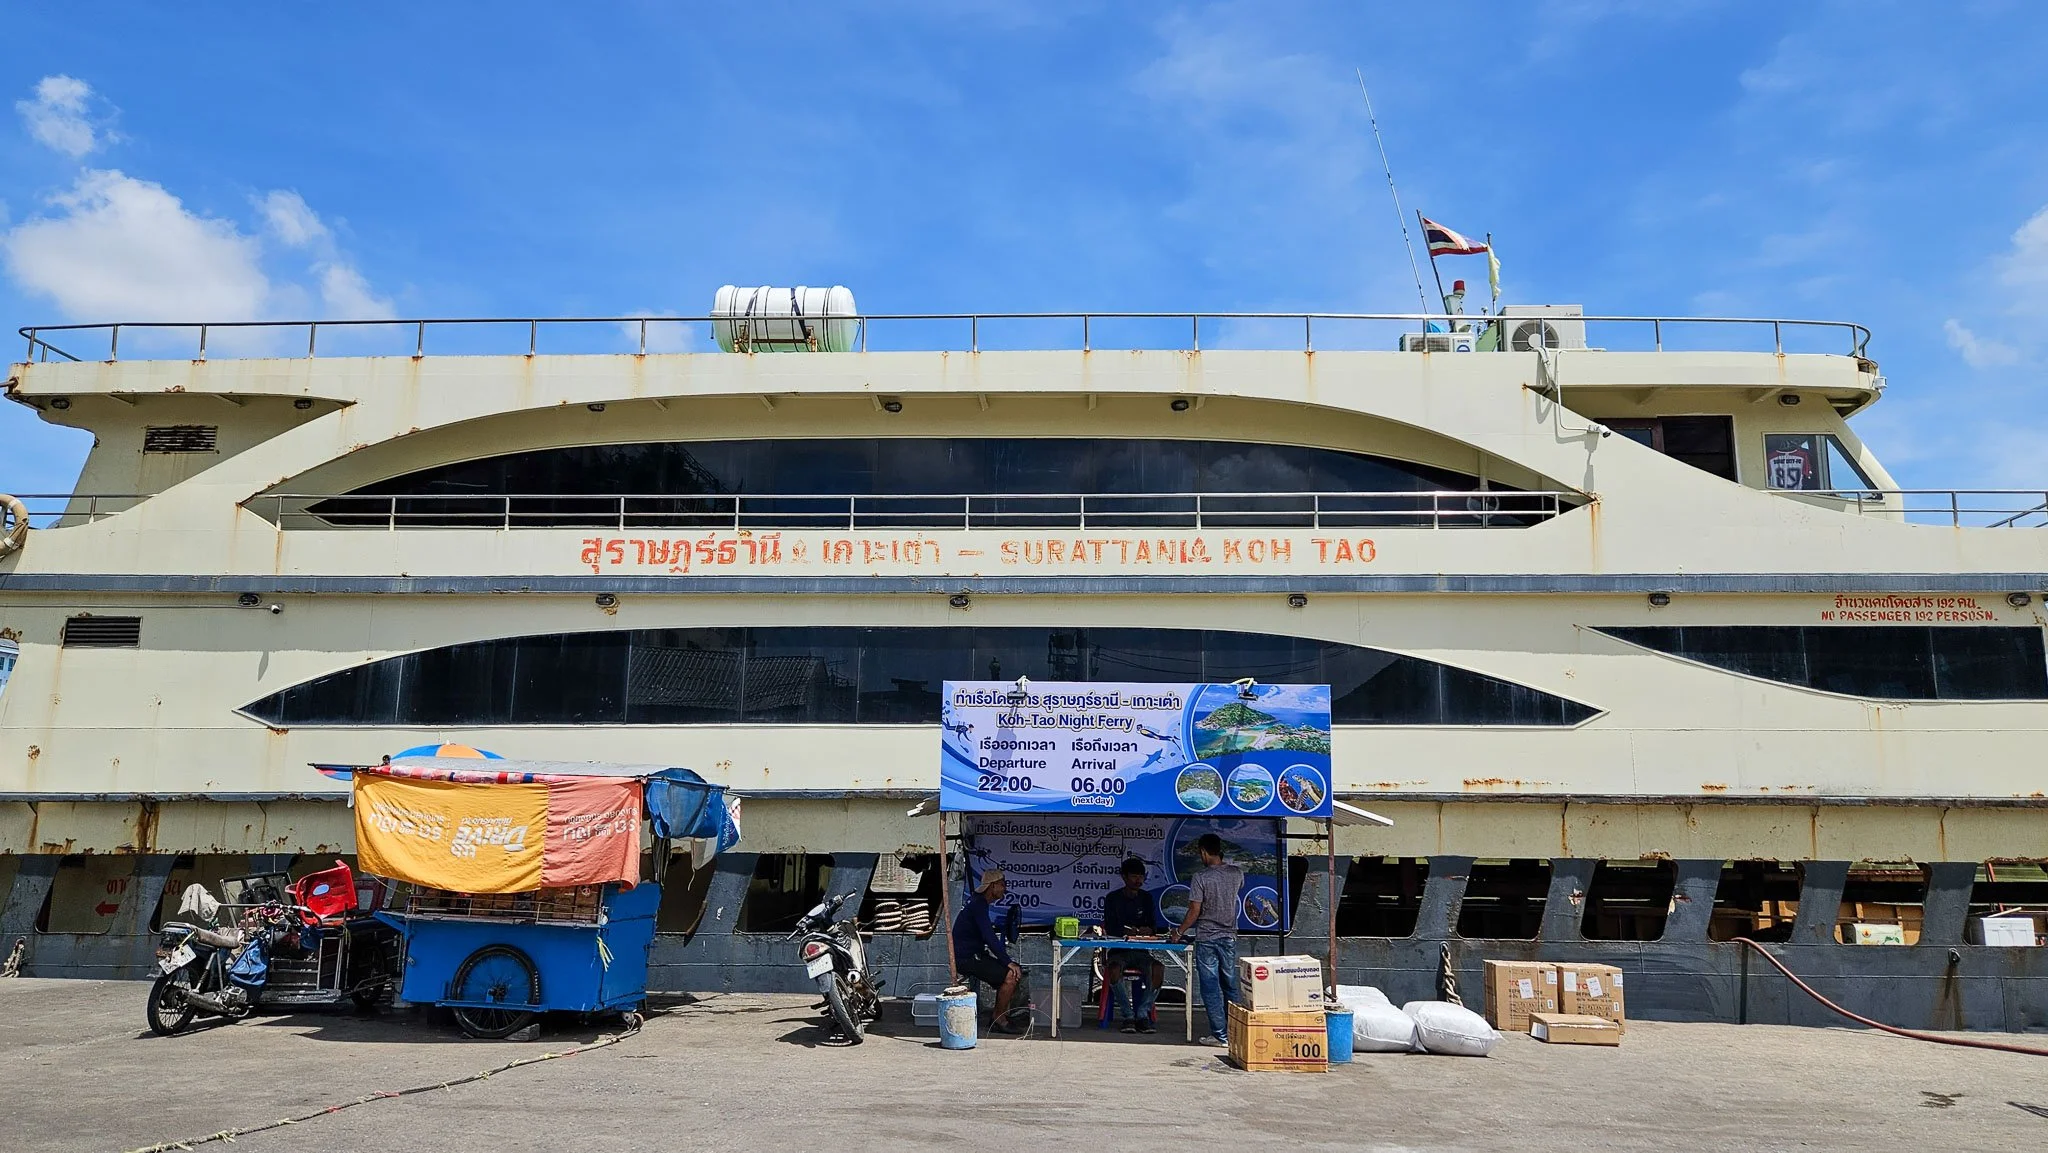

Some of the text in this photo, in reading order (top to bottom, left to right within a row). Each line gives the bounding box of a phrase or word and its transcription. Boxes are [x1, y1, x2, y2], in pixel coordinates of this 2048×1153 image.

[1001, 539, 1187, 565] SURATTANI
[1223, 538, 1291, 564] KOH
[1311, 538, 1376, 564] TAO
[1937, 597, 1955, 609] 192
[1821, 611, 1836, 621] NO
[1839, 611, 1912, 622] PASSENGER
[1915, 611, 1933, 622] 192
[1043, 690, 1119, 710] สุราษฎร์ธานี
[1133, 692, 1180, 707] เกาะเต่า
[998, 713, 1133, 730] Koh-Tao Night Ferry
[979, 736, 1056, 750] เรือออกเวลา
[1072, 737, 1138, 752] เรือถึงเวลา
[979, 756, 1047, 770] Departure
[1071, 758, 1116, 770] Arrival
[978, 775, 1032, 792] 22.00
[1071, 777, 1125, 793] 06.00
[1072, 796, 1114, 807] (next day)
[976, 821, 1046, 835] ท่าเรือโดยสาร
[1123, 824, 1163, 838] เกาะเต่า
[1011, 840, 1123, 856] Koh-Tao Night Ferry
[1073, 862, 1121, 875] เรือถึงเวล
[1005, 879, 1052, 890] eparture
[1072, 879, 1111, 890] Arrival
[995, 893, 1040, 908] 2200
[1072, 895, 1105, 909] 06.0
[1092, 911, 1105, 921] day
[1292, 1043, 1320, 1058] 100
